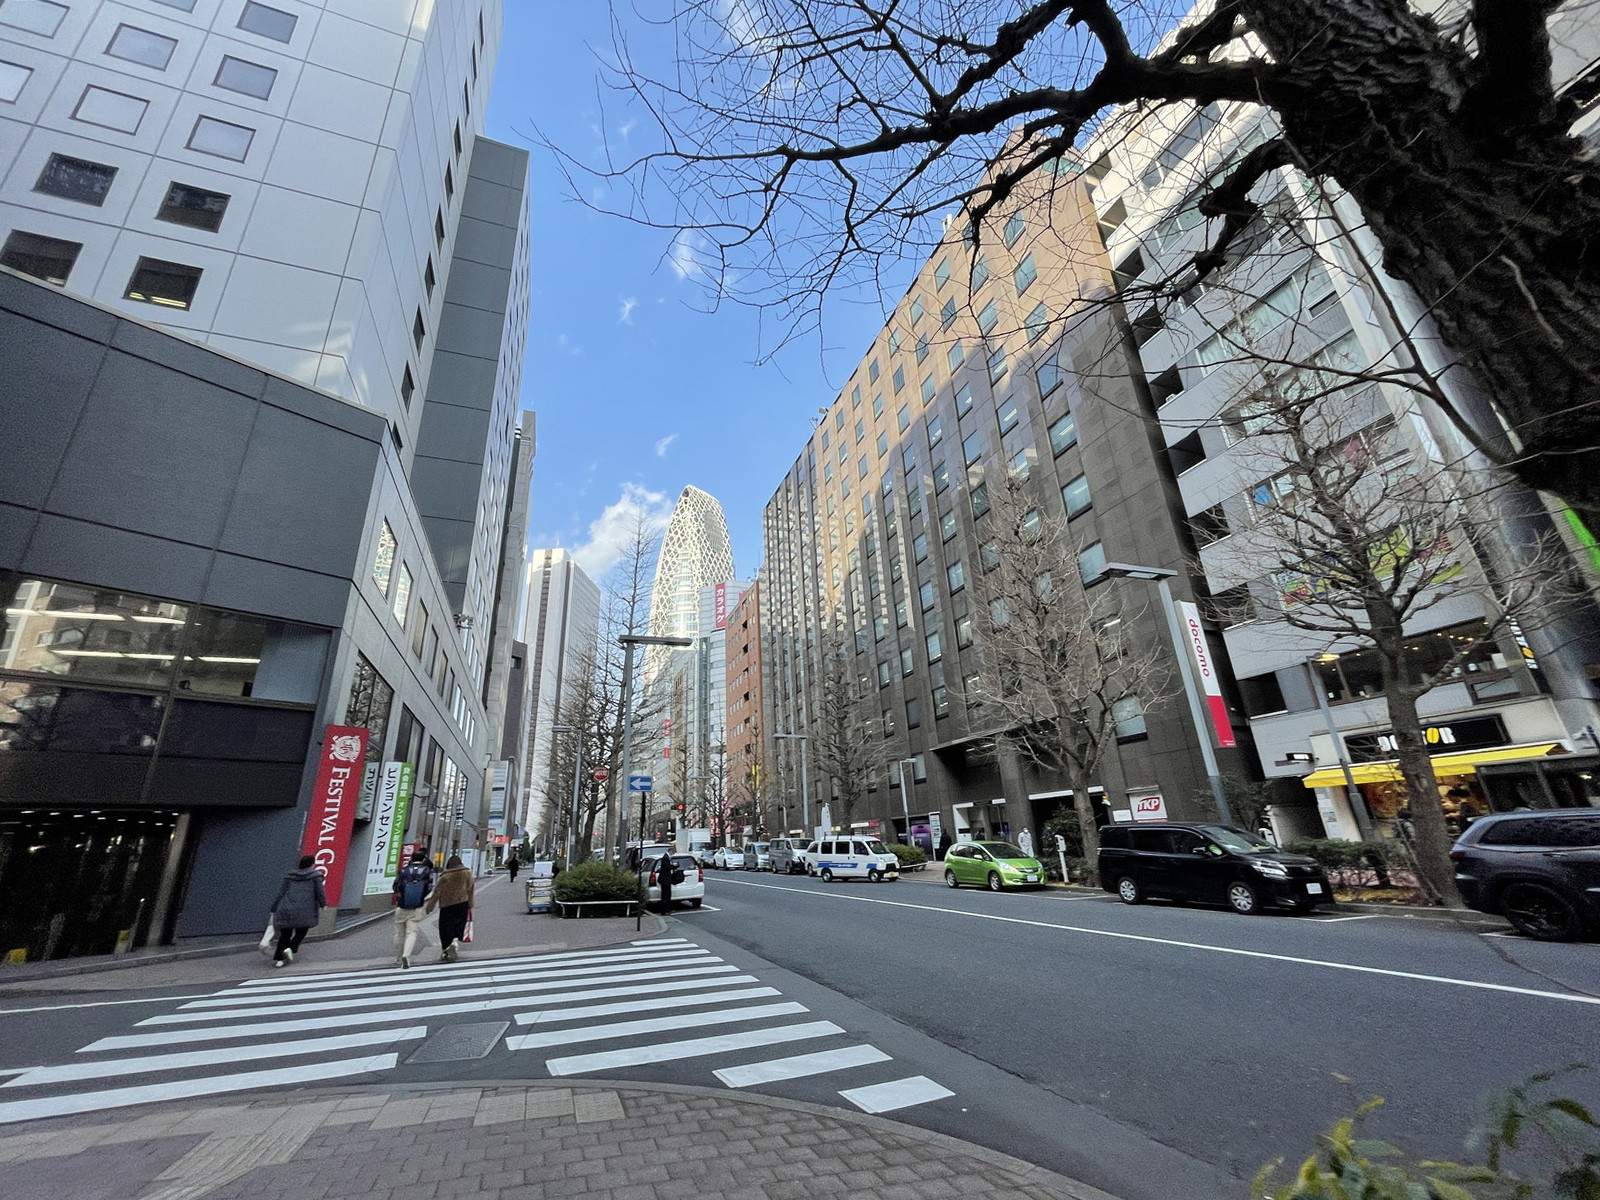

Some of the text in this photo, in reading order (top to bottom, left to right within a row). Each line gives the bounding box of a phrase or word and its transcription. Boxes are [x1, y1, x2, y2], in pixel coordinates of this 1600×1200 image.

[716, 588, 725, 623] カラオケ
[1189, 618, 1210, 677] docomo
[318, 767, 351, 846] FESTIVAL
[375, 768, 397, 866] ビジョンセンター
[1138, 798, 1160, 811] TKP
